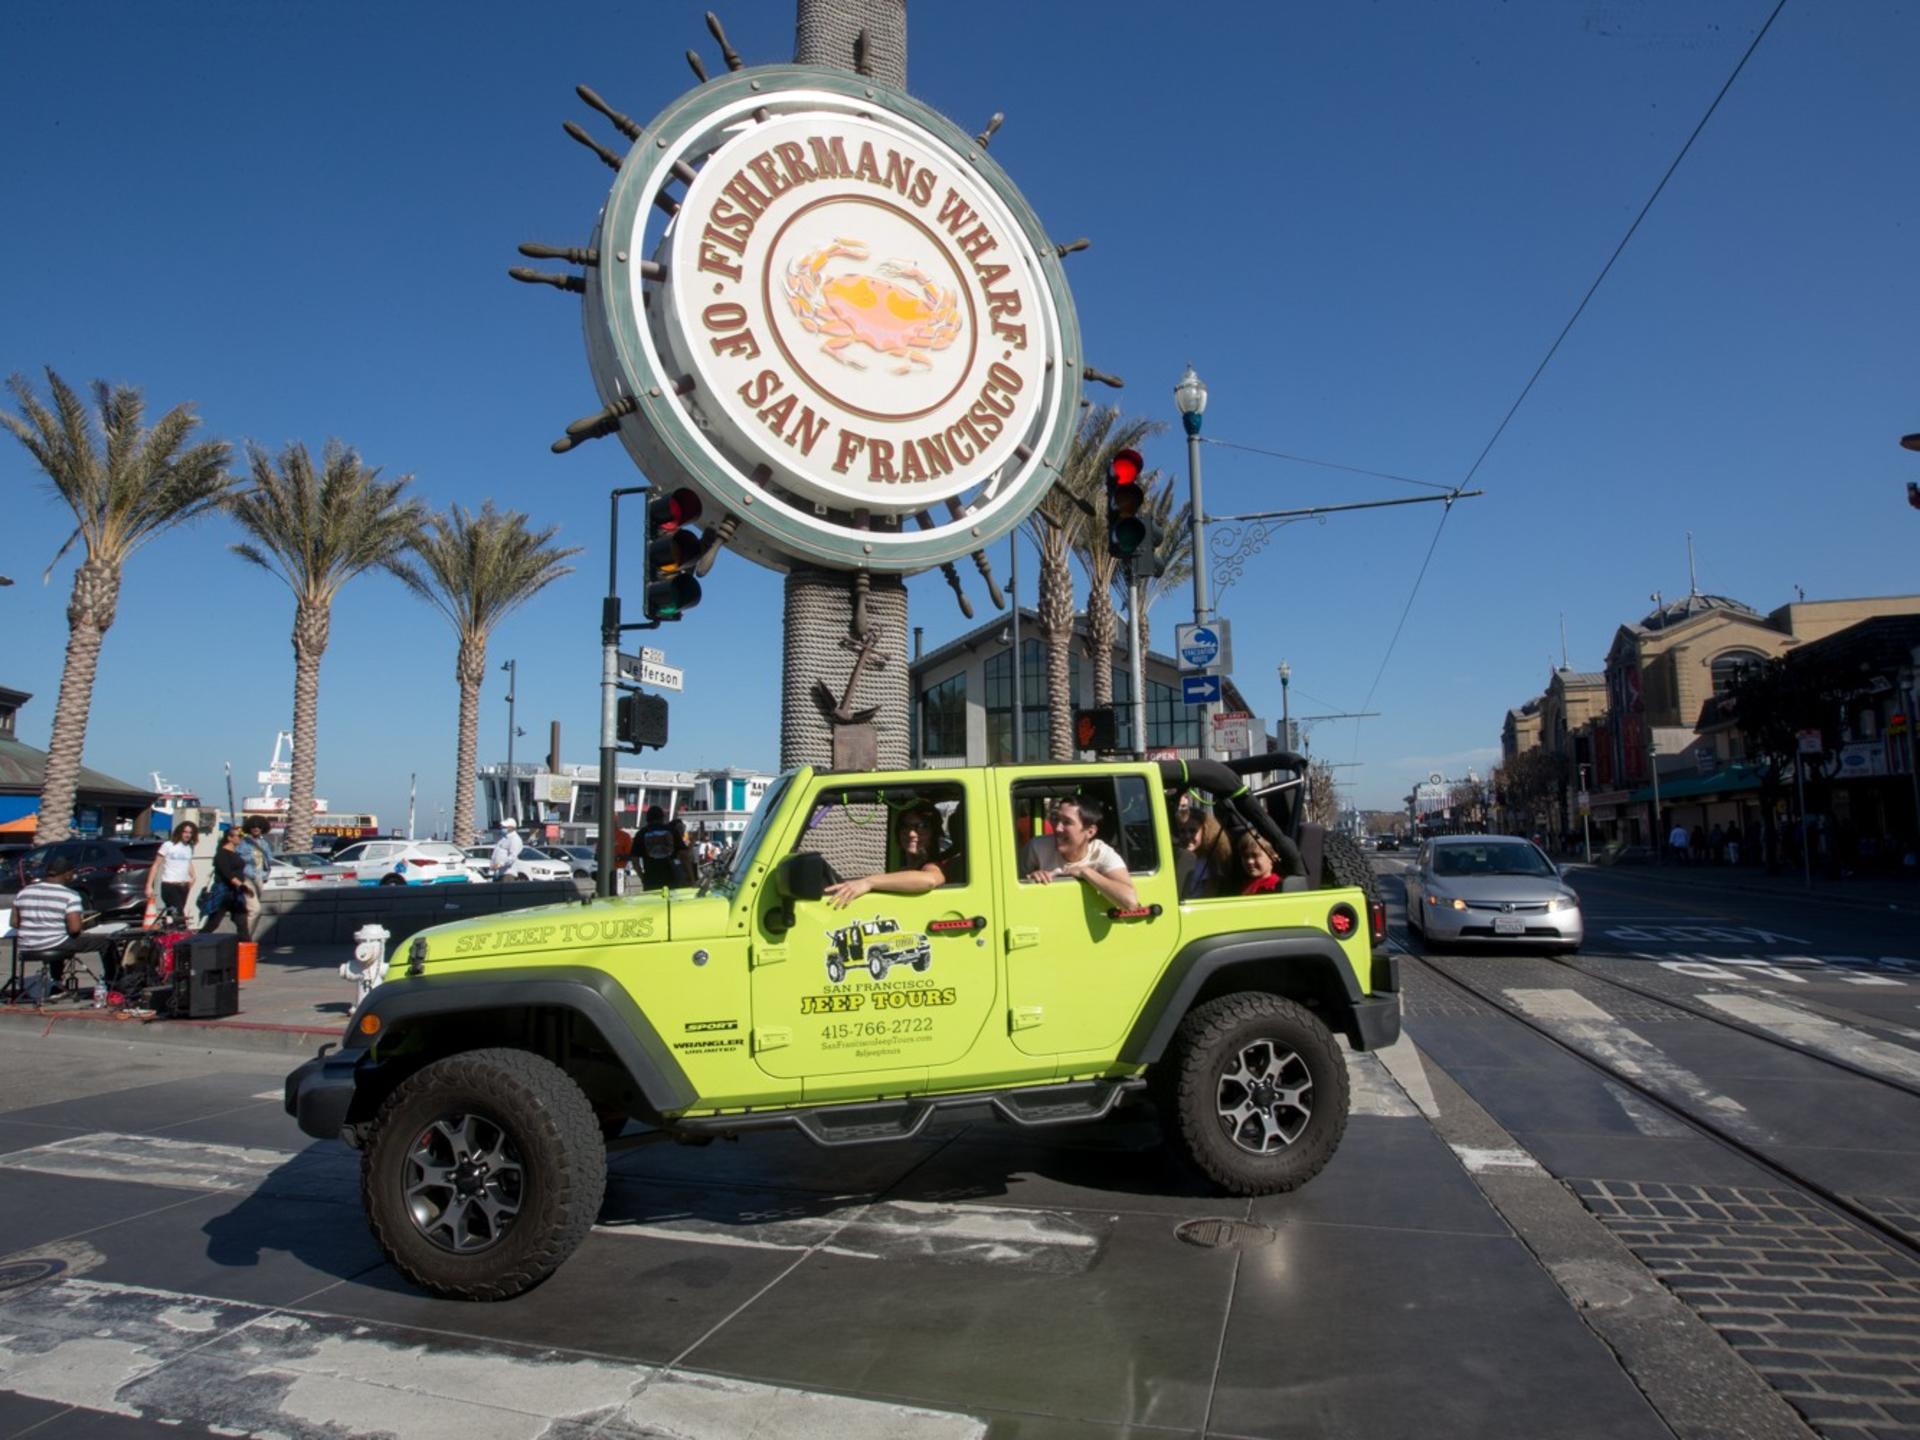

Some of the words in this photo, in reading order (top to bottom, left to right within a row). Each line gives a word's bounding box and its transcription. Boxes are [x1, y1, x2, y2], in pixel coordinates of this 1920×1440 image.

[698, 136, 938, 283] FISHERMANS
[937, 187, 1028, 350] WHARF
[703, 302, 761, 361] OF
[738, 369, 829, 457] SAN
[832, 361, 1025, 484] FRANCISCO
[1150, 752, 1175, 761] OPEN
[456, 932, 494, 951] SF
[492, 926, 556, 948] JEEP
[560, 917, 655, 942] TOURS
[823, 984, 851, 994] SAN
[856, 979, 935, 992] FRANCISCO
[801, 994, 865, 1014] JEEP
[872, 987, 957, 1010] TOURS
[686, 1021, 736, 1031] SPORT
[821, 1017, 933, 1039] 415-766-2722
[673, 1038, 744, 1049] WRANGLER
